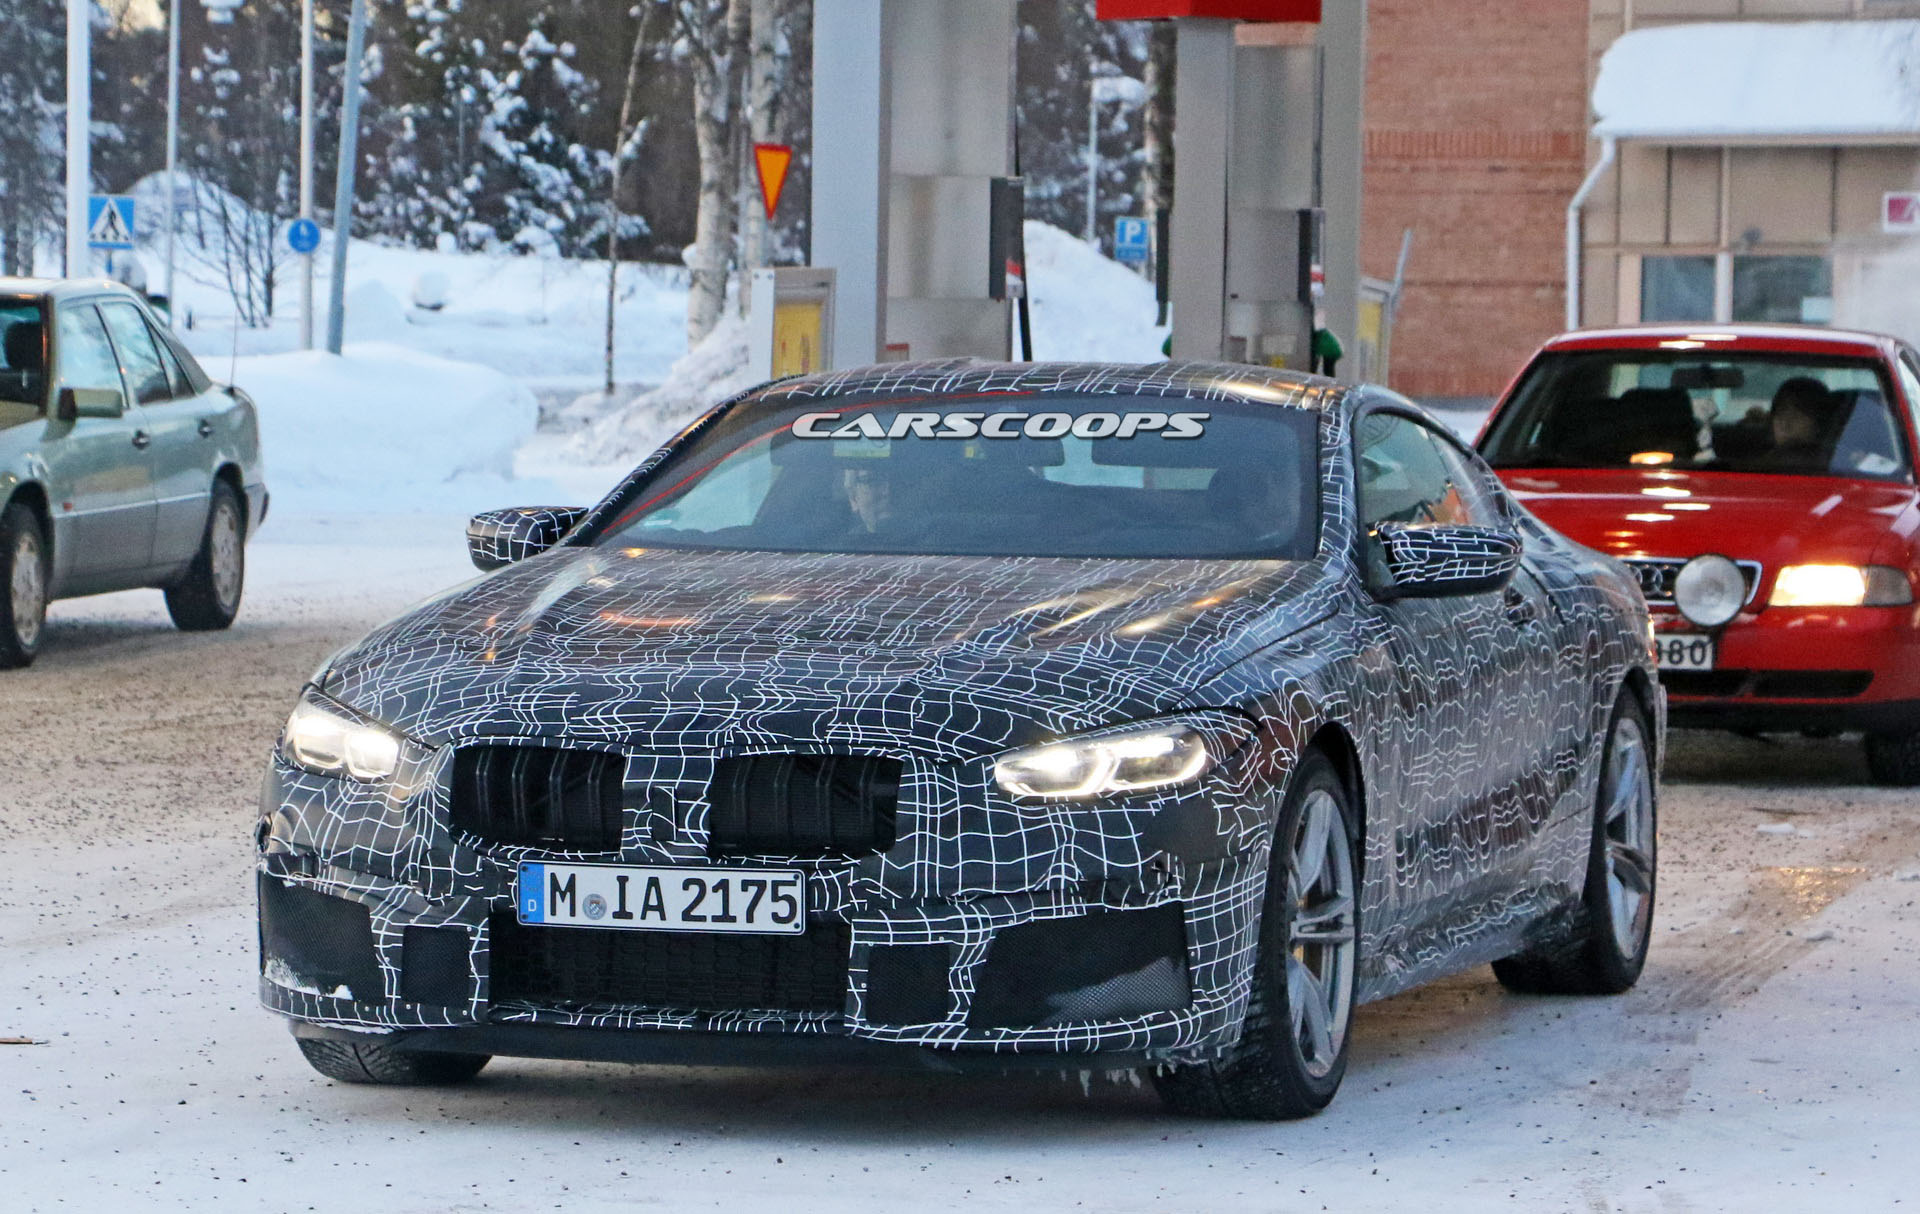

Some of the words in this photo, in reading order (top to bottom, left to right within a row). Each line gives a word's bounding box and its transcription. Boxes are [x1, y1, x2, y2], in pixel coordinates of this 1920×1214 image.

[1125, 220, 1142, 243] P
[527, 899, 537, 912] D
[550, 872, 576, 917] M
[612, 875, 667, 922] IA
[681, 877, 799, 925] 2175
